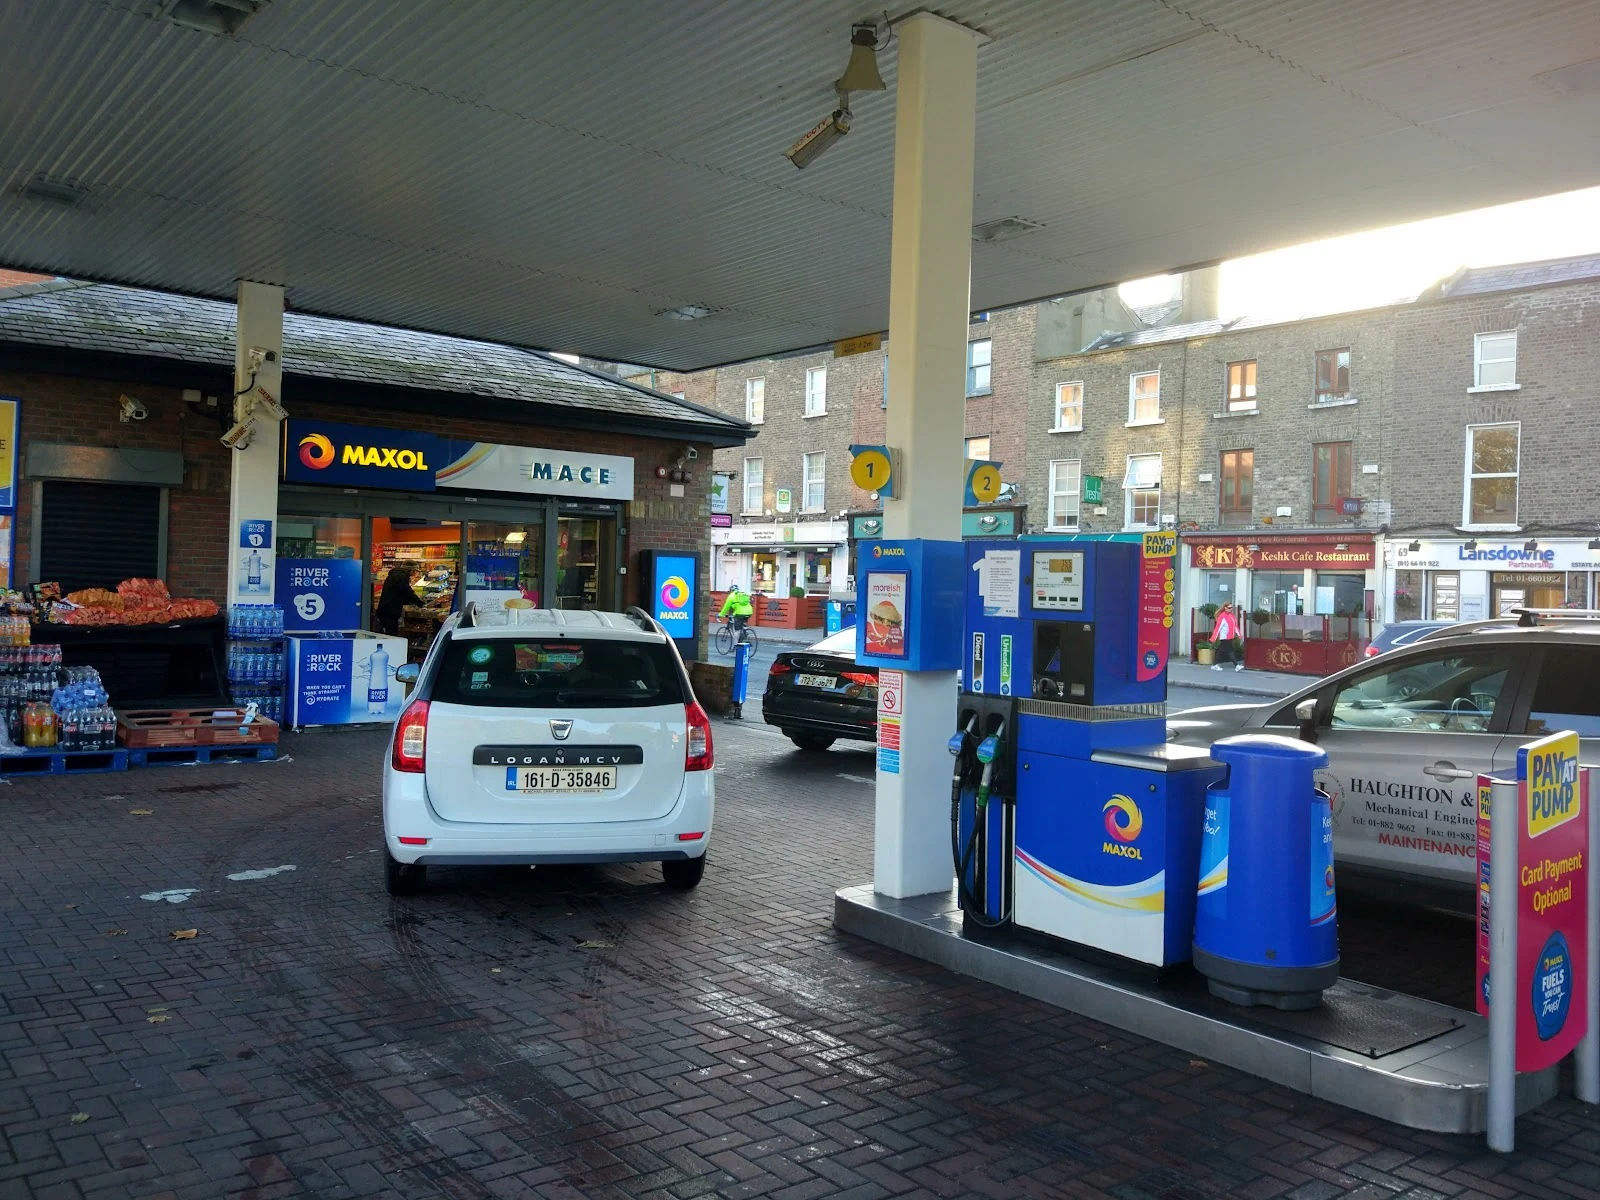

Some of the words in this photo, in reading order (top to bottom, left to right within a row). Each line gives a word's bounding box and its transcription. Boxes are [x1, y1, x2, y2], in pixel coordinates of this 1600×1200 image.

[342, 445, 428, 471] MAXOL
[532, 462, 610, 484] MACE
[866, 463, 874, 478] 1
[983, 476, 991, 491] 2
[1146, 536, 1166, 545] PAY
[883, 548, 905, 556] MAXOL
[1146, 546, 1172, 554] PUMP
[1218, 549, 1231, 563] K
[1261, 552, 1289, 561] Keshk
[1292, 552, 1313, 561] Cafe
[1316, 552, 1370, 561] Restaurant
[1398, 548, 1408, 557] 69
[1459, 545, 1554, 561] Lansdowne
[295, 568, 329, 576] RIVER
[1516, 575, 1560, 583] 01-6601922
[295, 577, 329, 587] ROCK
[873, 584, 900, 592] moreish
[660, 611, 689, 620] MAXOL
[1280, 652, 1290, 663] K
[311, 663, 341, 671] ROCK
[491, 756, 565, 764] LOGAN
[580, 756, 621, 764] MCV
[1532, 751, 1564, 788] PAY
[1562, 760, 1576, 783] AT
[525, 772, 610, 788] 161-D-35846
[1351, 778, 1453, 804] HAUGHTON
[1461, 791, 1474, 807] &
[1365, 801, 1428, 819] Mechanical
[1532, 785, 1573, 821] PUMP
[1351, 816, 1366, 825] Tel:
[1368, 820, 1394, 830] 01-882
[1397, 823, 1415, 833] 9662
[1426, 827, 1443, 837] Fax:
[1447, 831, 1475, 842] 01-882
[1102, 842, 1142, 860] MAXOL
[1379, 833, 1476, 858] MAINTENANC
[1522, 861, 1543, 886] Card
[1545, 852, 1582, 881] Payment
[1533, 880, 1571, 915] Optional
[1542, 968, 1565, 992] FUELS
[1544, 989, 1552, 999] YOU
[1552, 985, 1561, 997] CAN
[1542, 992, 1565, 1017] Trust
